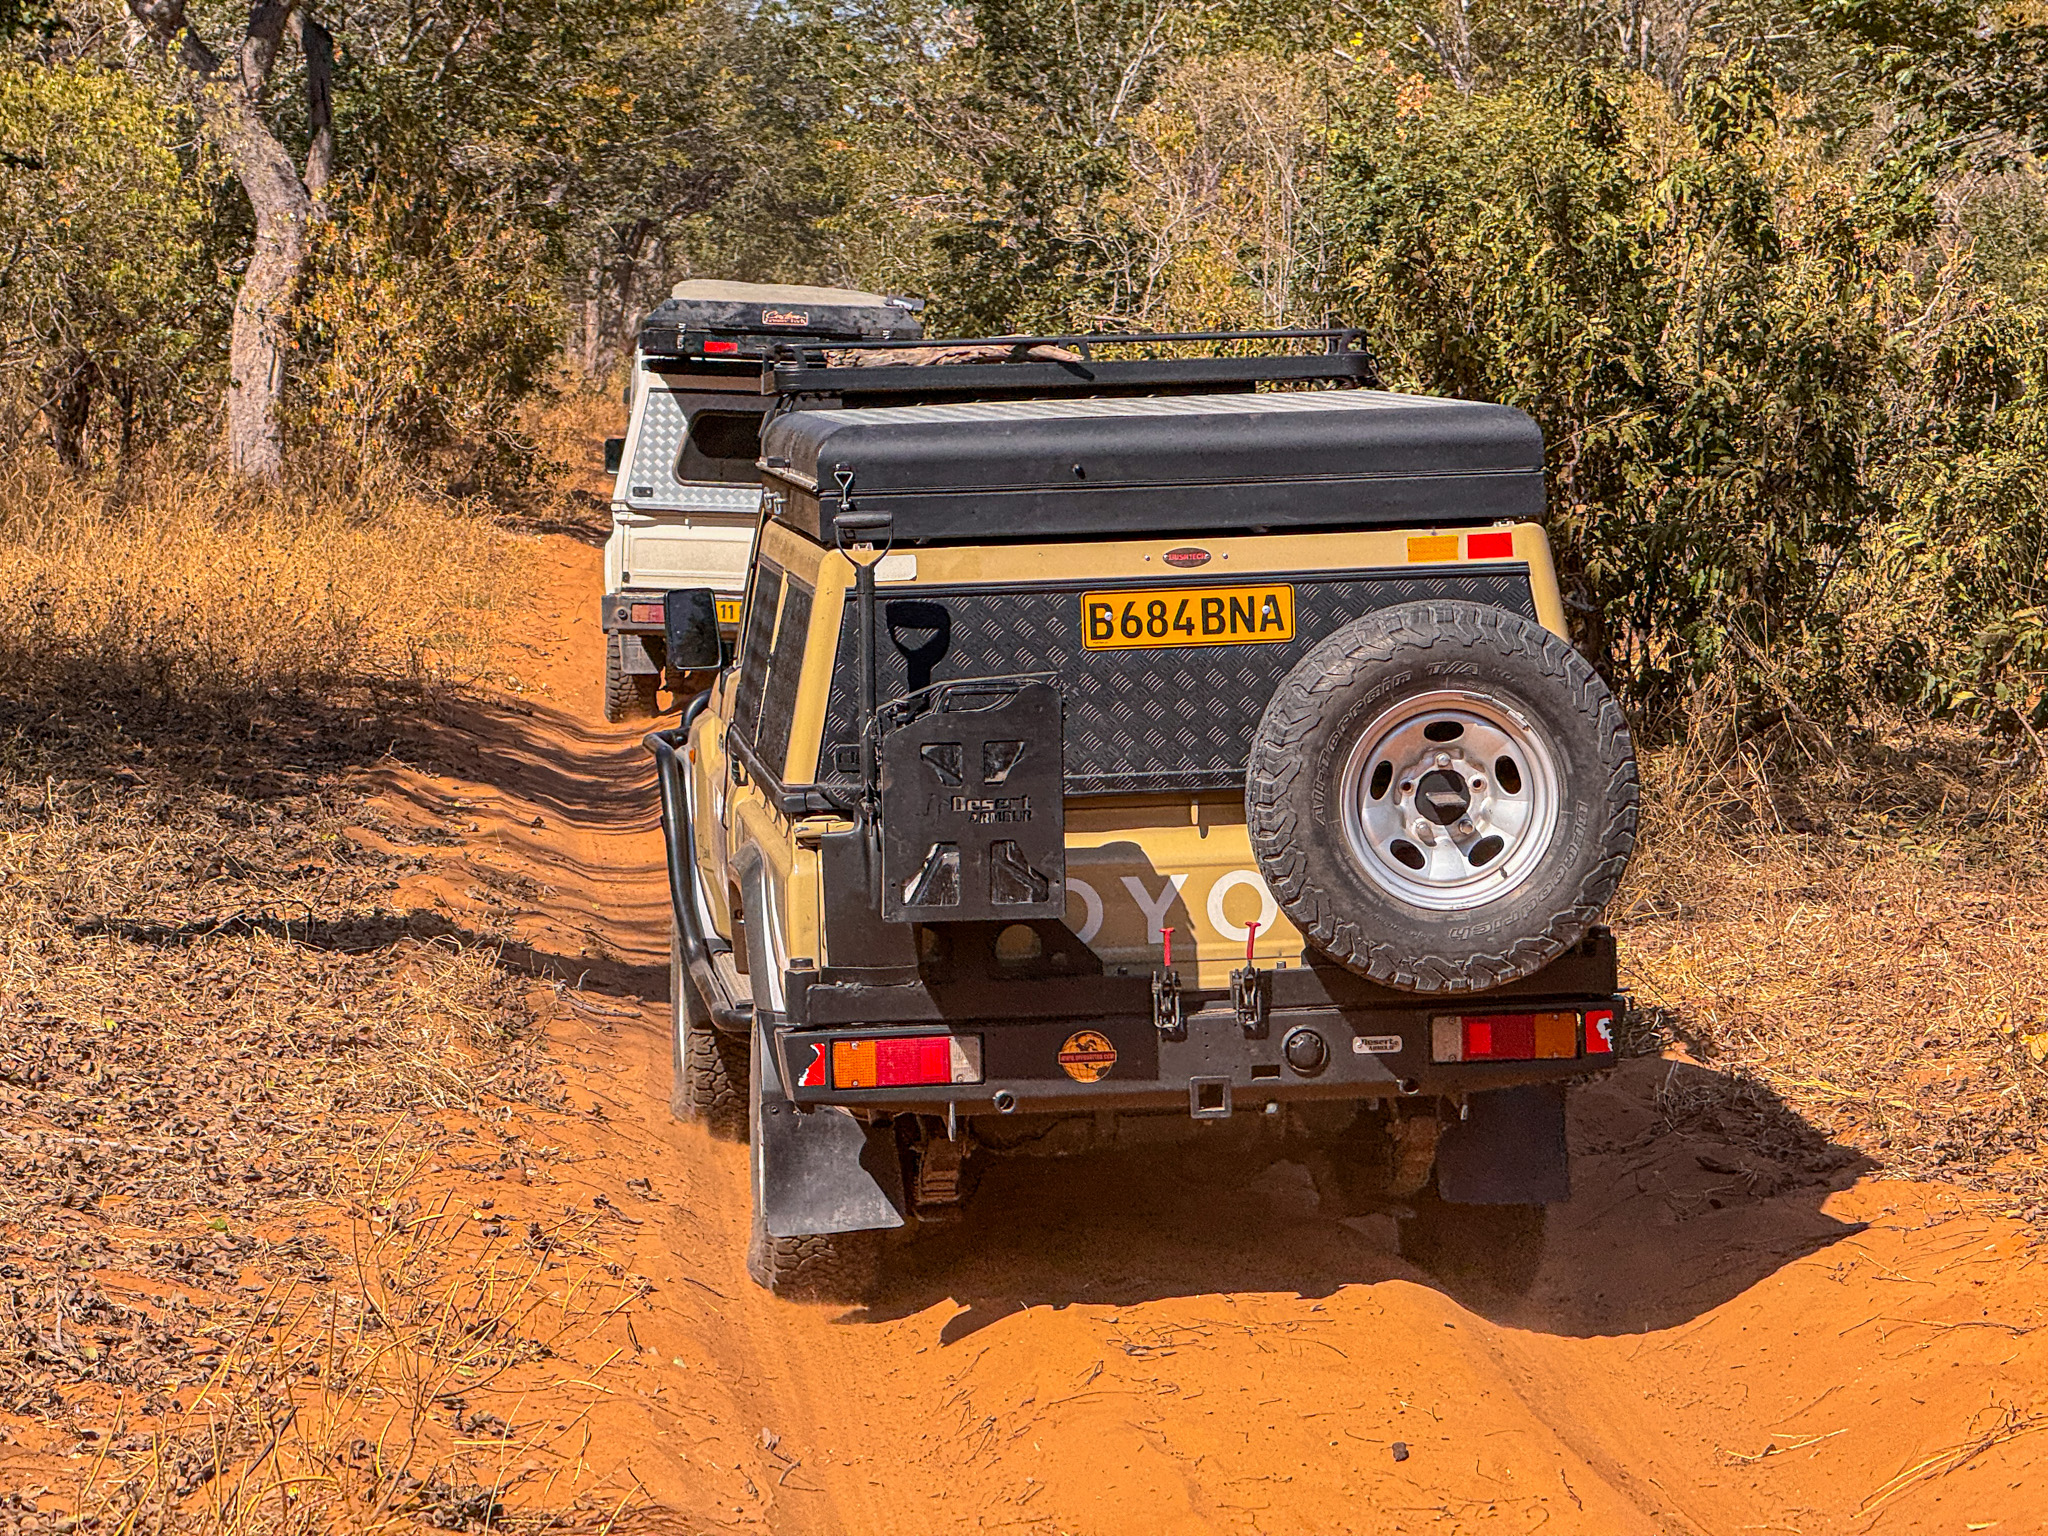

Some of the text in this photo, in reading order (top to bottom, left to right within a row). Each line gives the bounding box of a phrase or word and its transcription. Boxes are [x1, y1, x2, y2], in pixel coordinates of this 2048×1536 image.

[1089, 594, 1285, 641] B684BNA
[1312, 670, 1412, 826] All-Terrain
[951, 795, 1031, 812] Desert
[968, 810, 1032, 824] ARMOUR
[1065, 869, 1279, 943] OYO
